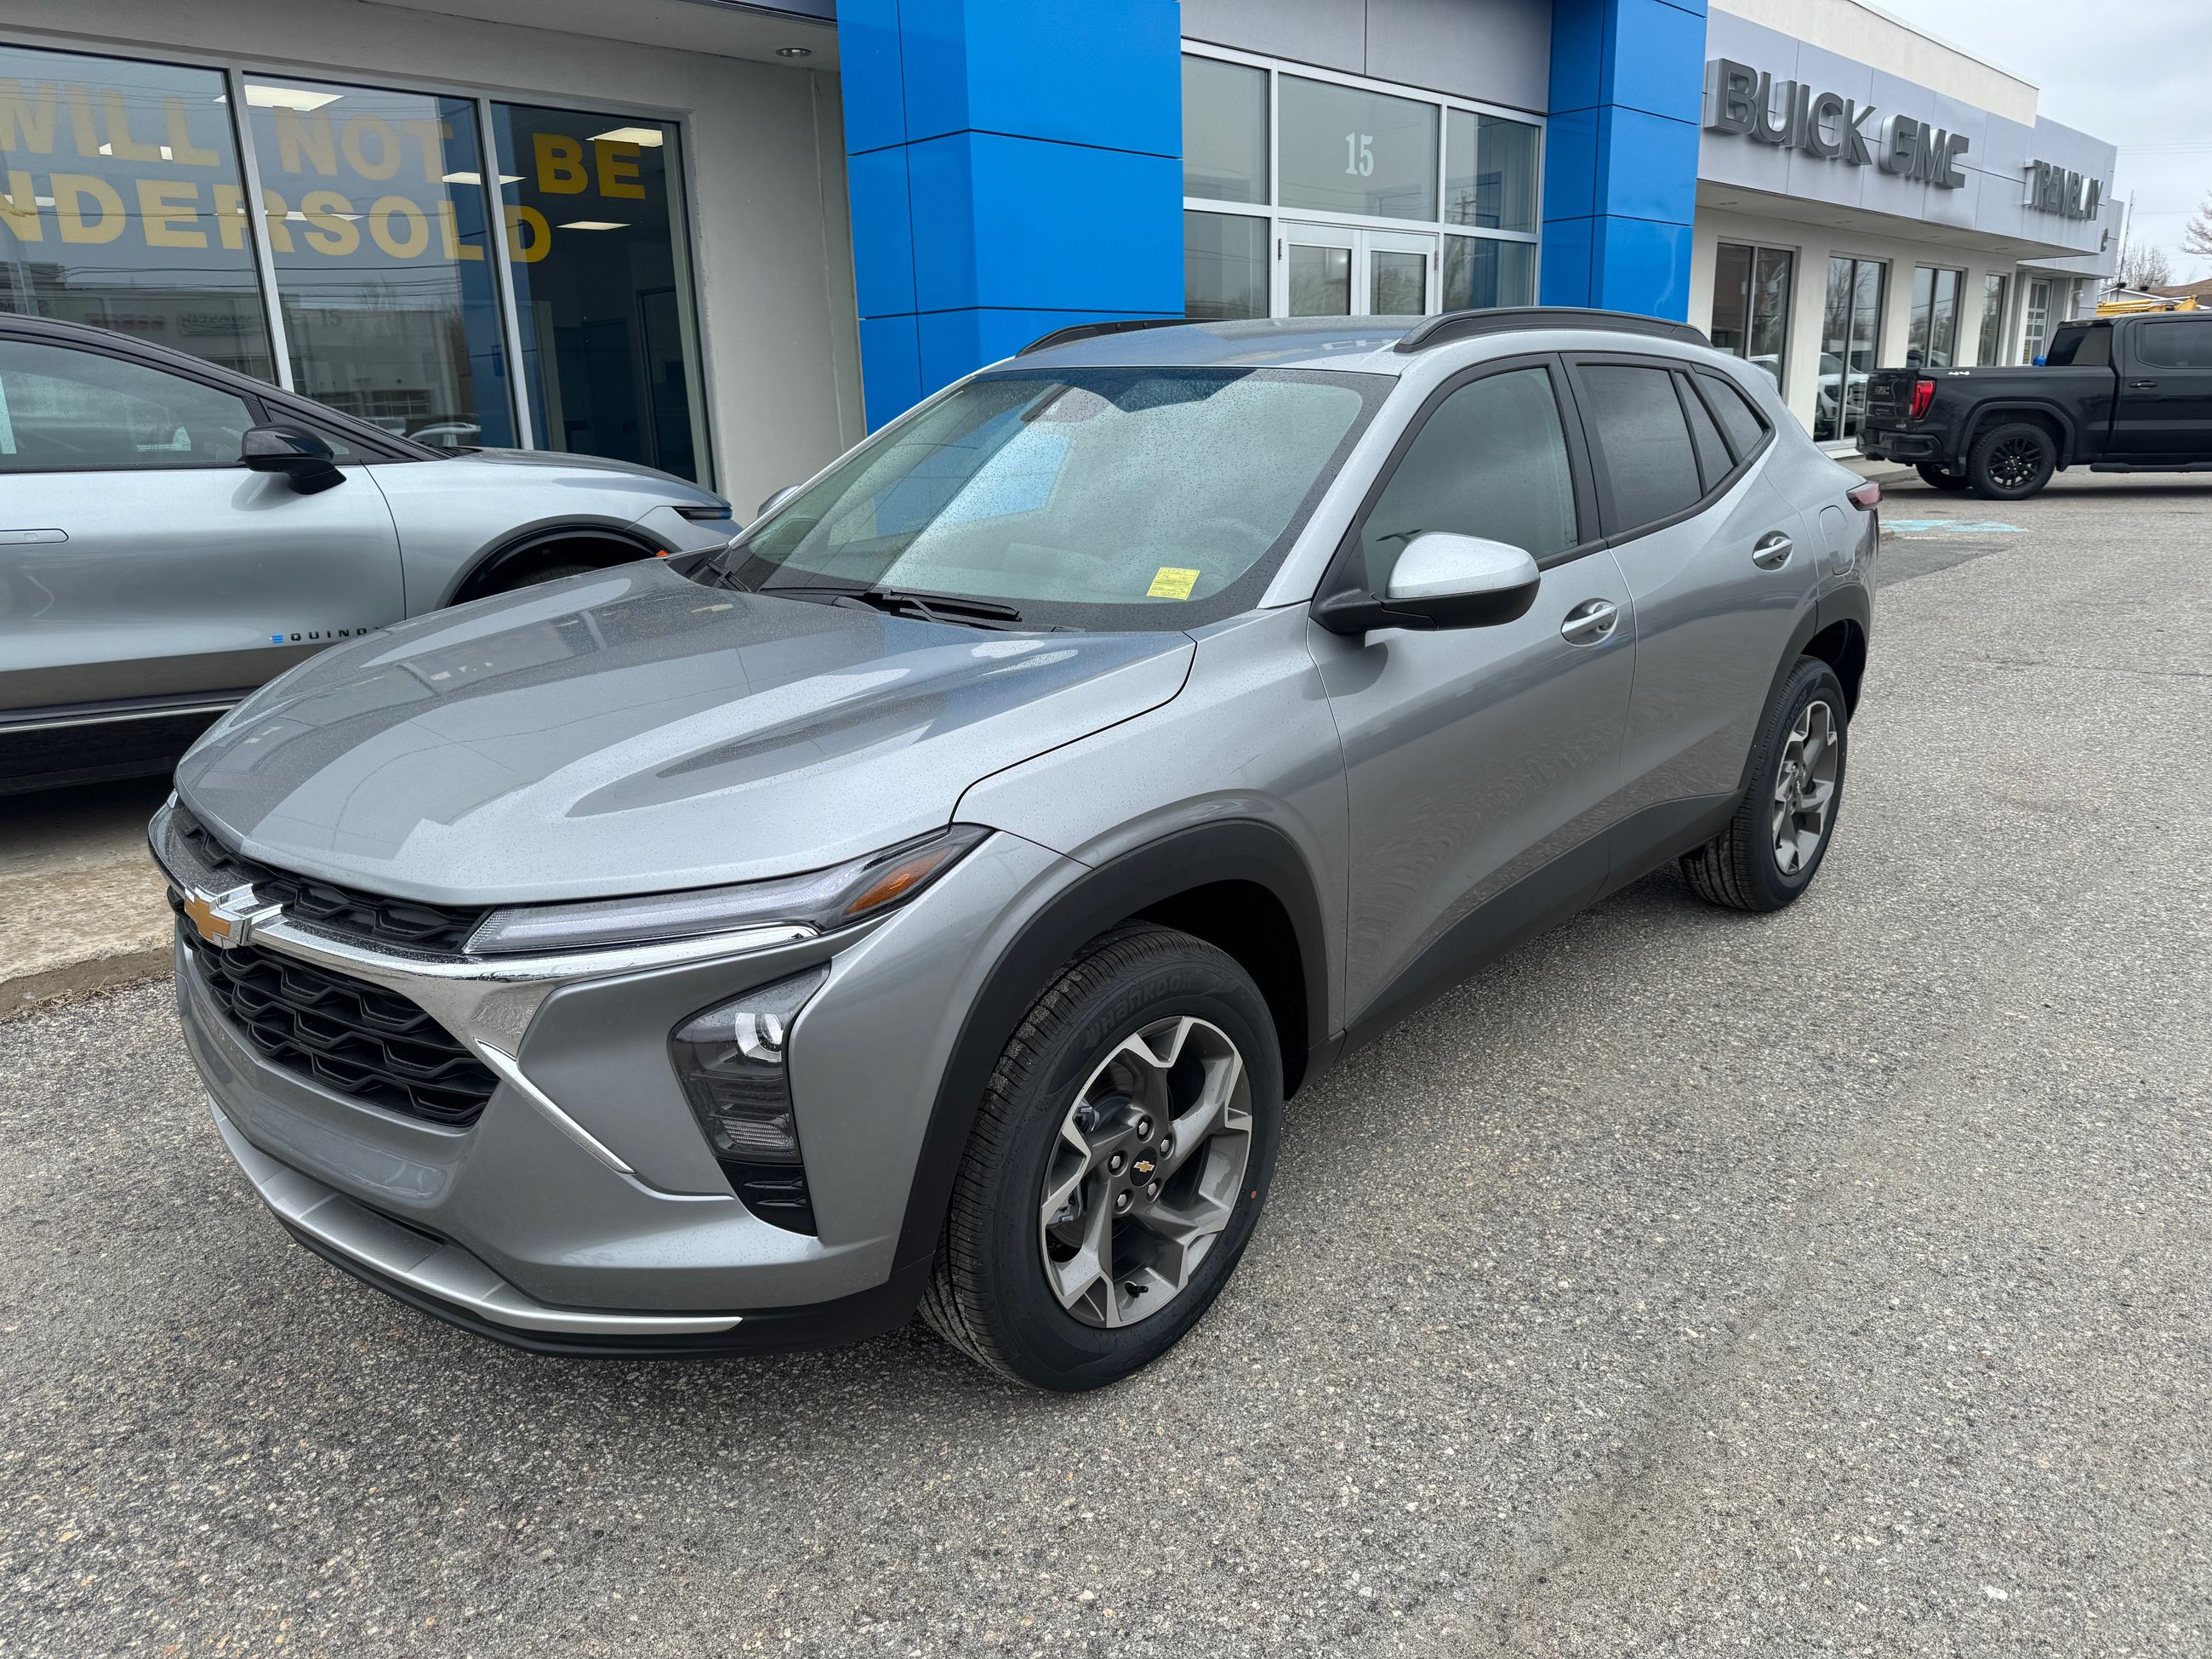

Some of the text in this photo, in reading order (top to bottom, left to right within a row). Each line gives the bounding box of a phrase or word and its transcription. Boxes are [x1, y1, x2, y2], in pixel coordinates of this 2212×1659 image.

[272, 105, 453, 185] NOT
[532, 133, 646, 200] BE
[1705, 58, 1877, 165] BUICK
[1879, 114, 1970, 188] GMC
[1345, 132, 1374, 177] 15
